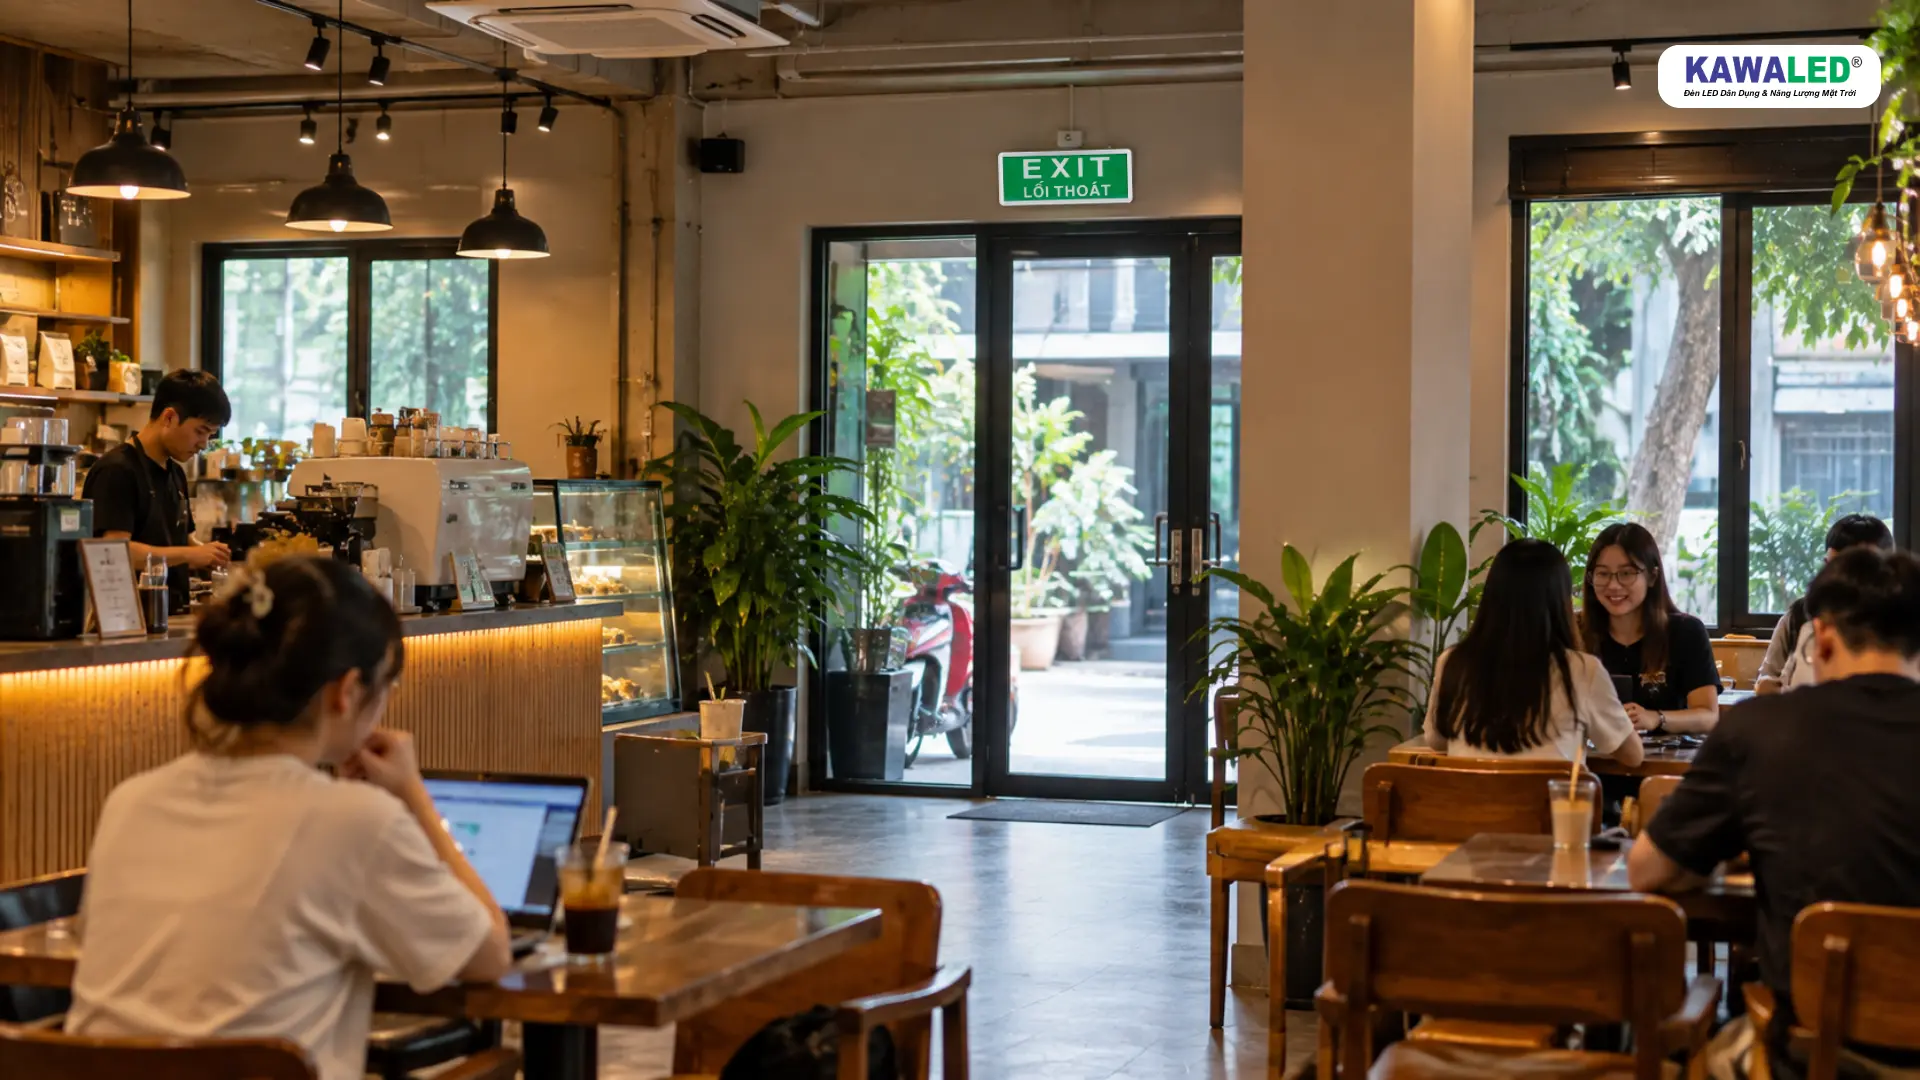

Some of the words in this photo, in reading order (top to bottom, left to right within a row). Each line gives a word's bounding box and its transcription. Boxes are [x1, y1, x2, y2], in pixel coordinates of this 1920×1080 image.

[1023, 157, 1110, 179] EXIT
[1024, 181, 1049, 198] LỐI
[1054, 181, 1111, 197] THOÁT
